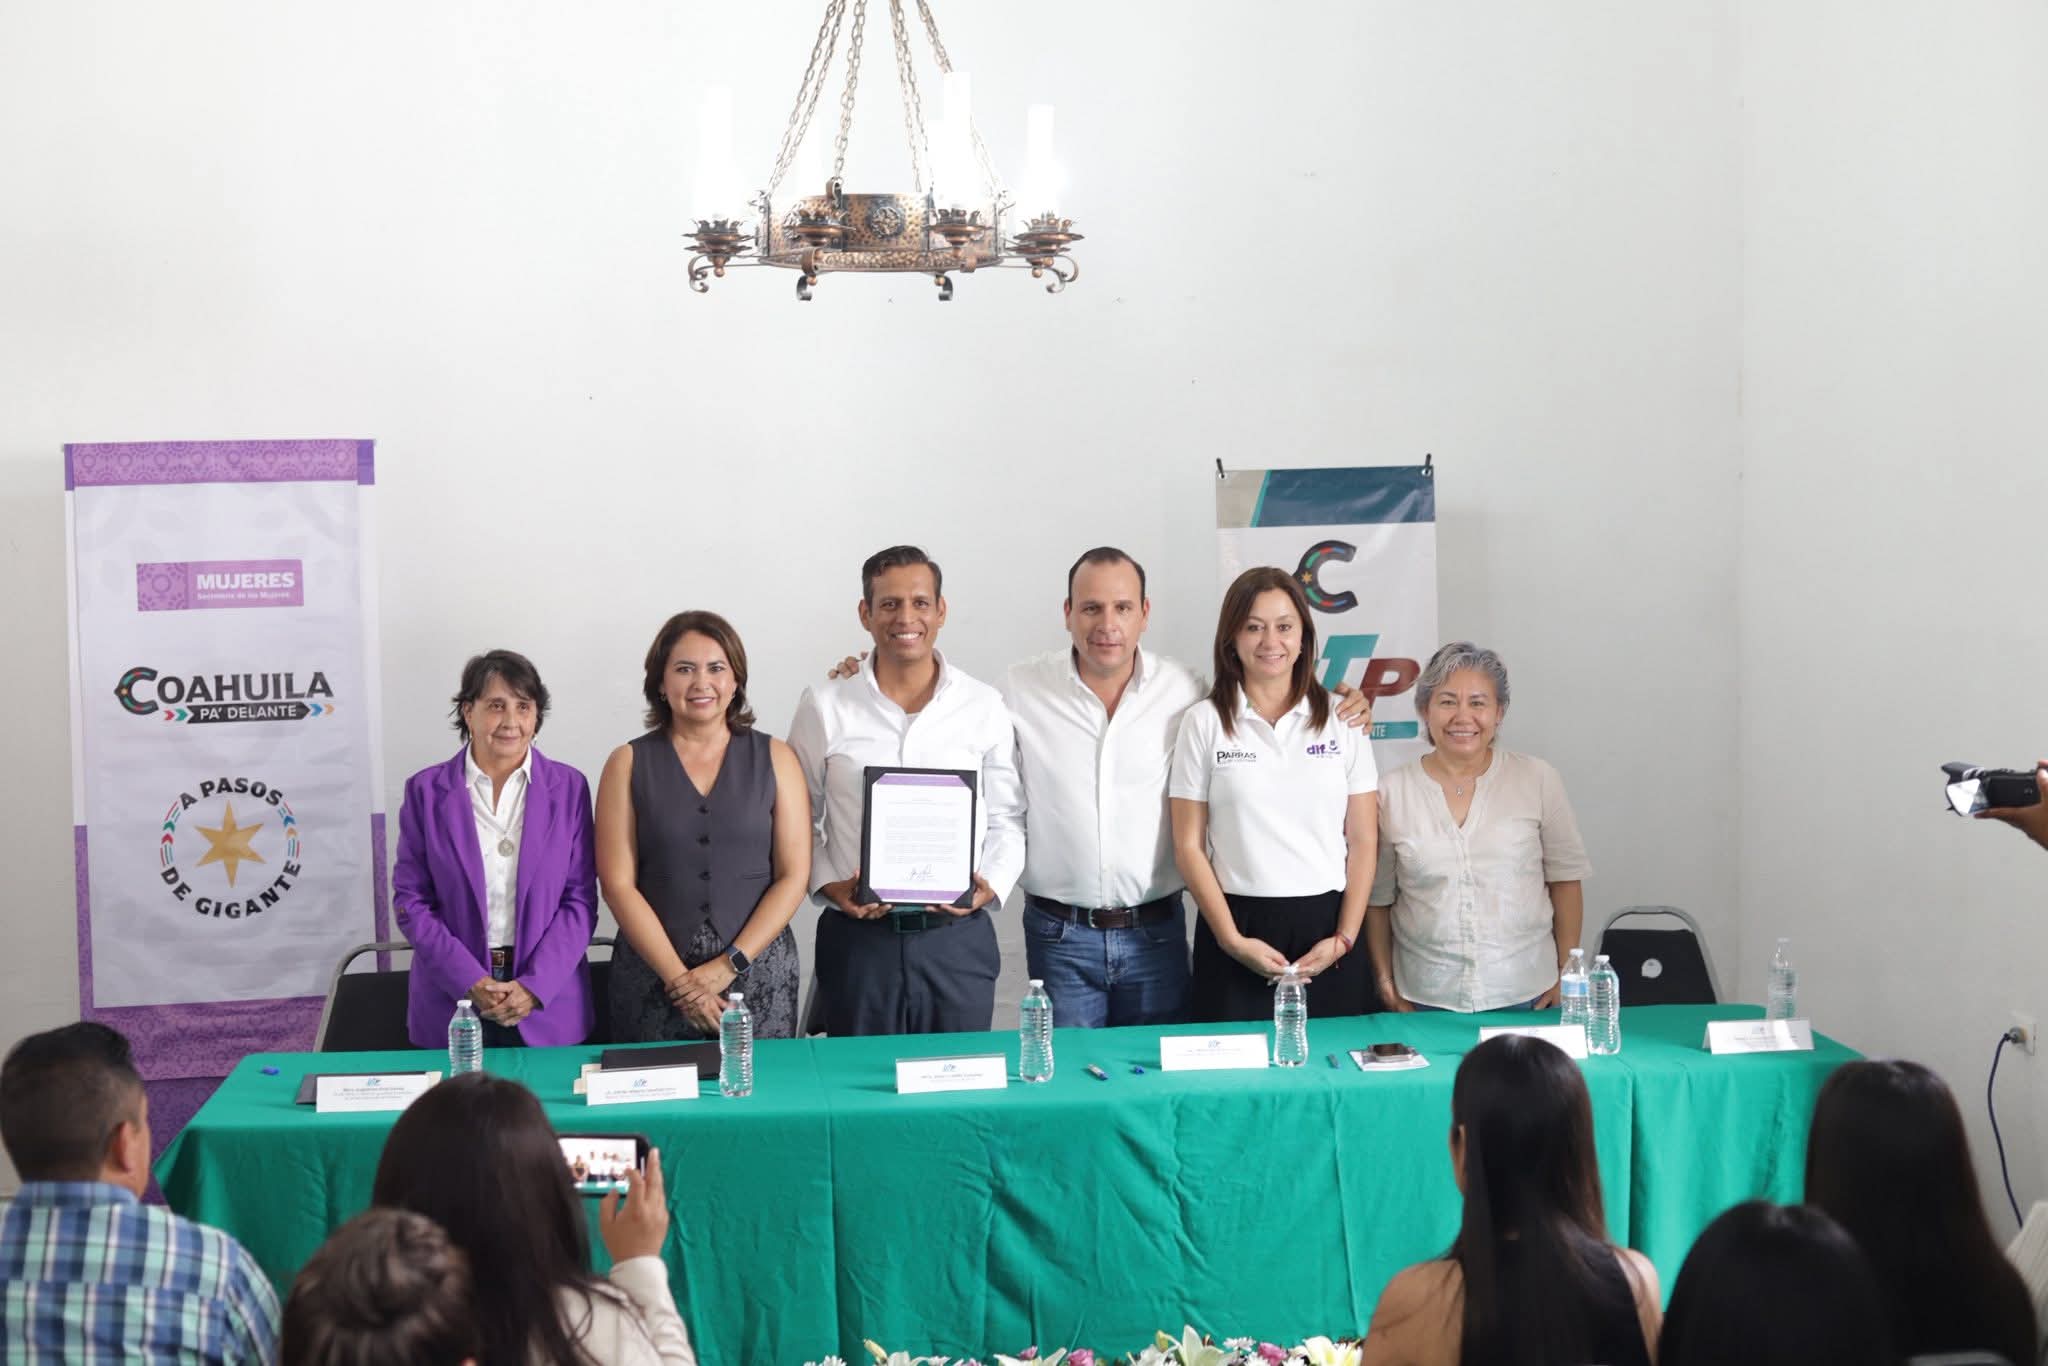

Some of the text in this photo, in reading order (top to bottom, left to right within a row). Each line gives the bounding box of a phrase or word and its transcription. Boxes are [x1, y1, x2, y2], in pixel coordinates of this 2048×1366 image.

[197, 572, 295, 590] MUJERES
[1314, 634, 1421, 710] TP
[114, 667, 334, 715] COAHUILA
[227, 705, 297, 719] DELANTE
[1217, 751, 1257, 763] PARRAS
[1306, 744, 1326, 755] dif
[180, 777, 283, 810] A PASOS
[161, 860, 301, 919] DE GIGANTE
